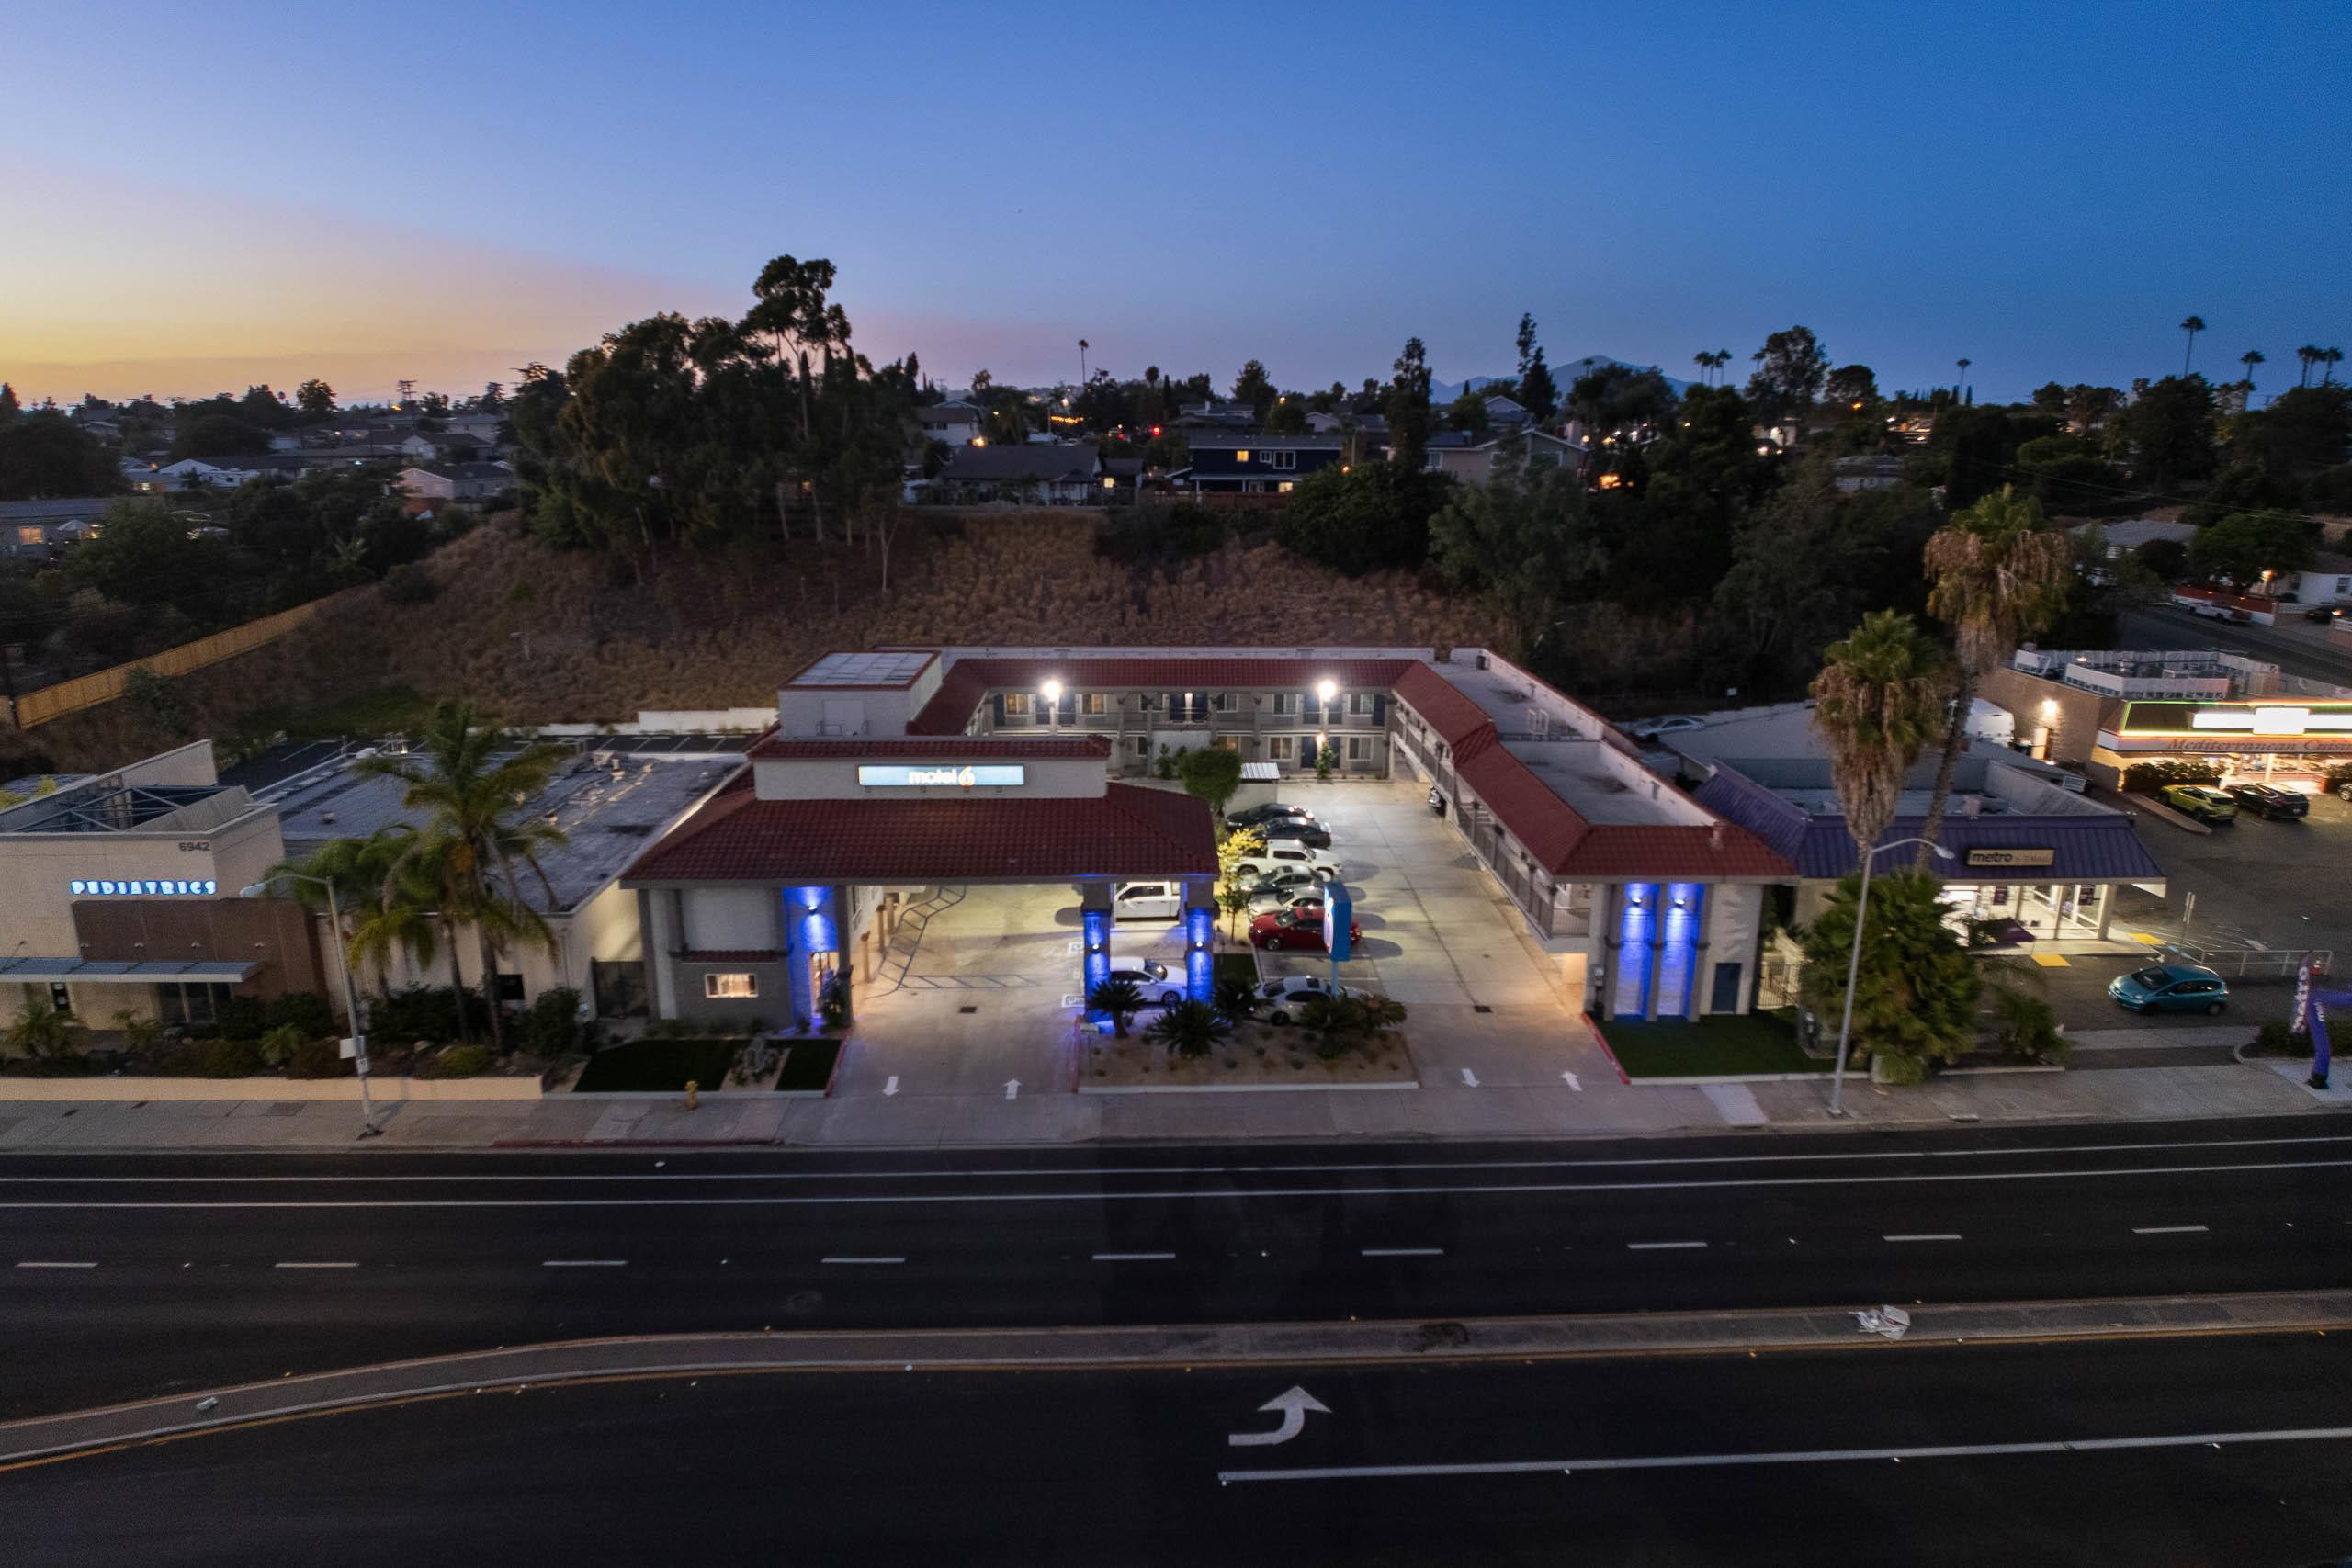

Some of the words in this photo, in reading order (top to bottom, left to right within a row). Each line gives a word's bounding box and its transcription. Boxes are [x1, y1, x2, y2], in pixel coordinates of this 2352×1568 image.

[2167, 739, 2296, 751] Mediterranean
[958, 765, 976, 786] 6
[177, 841, 210, 852] 6942
[1972, 852, 2013, 863] metro
[71, 880, 217, 895] PEDIATRICS
